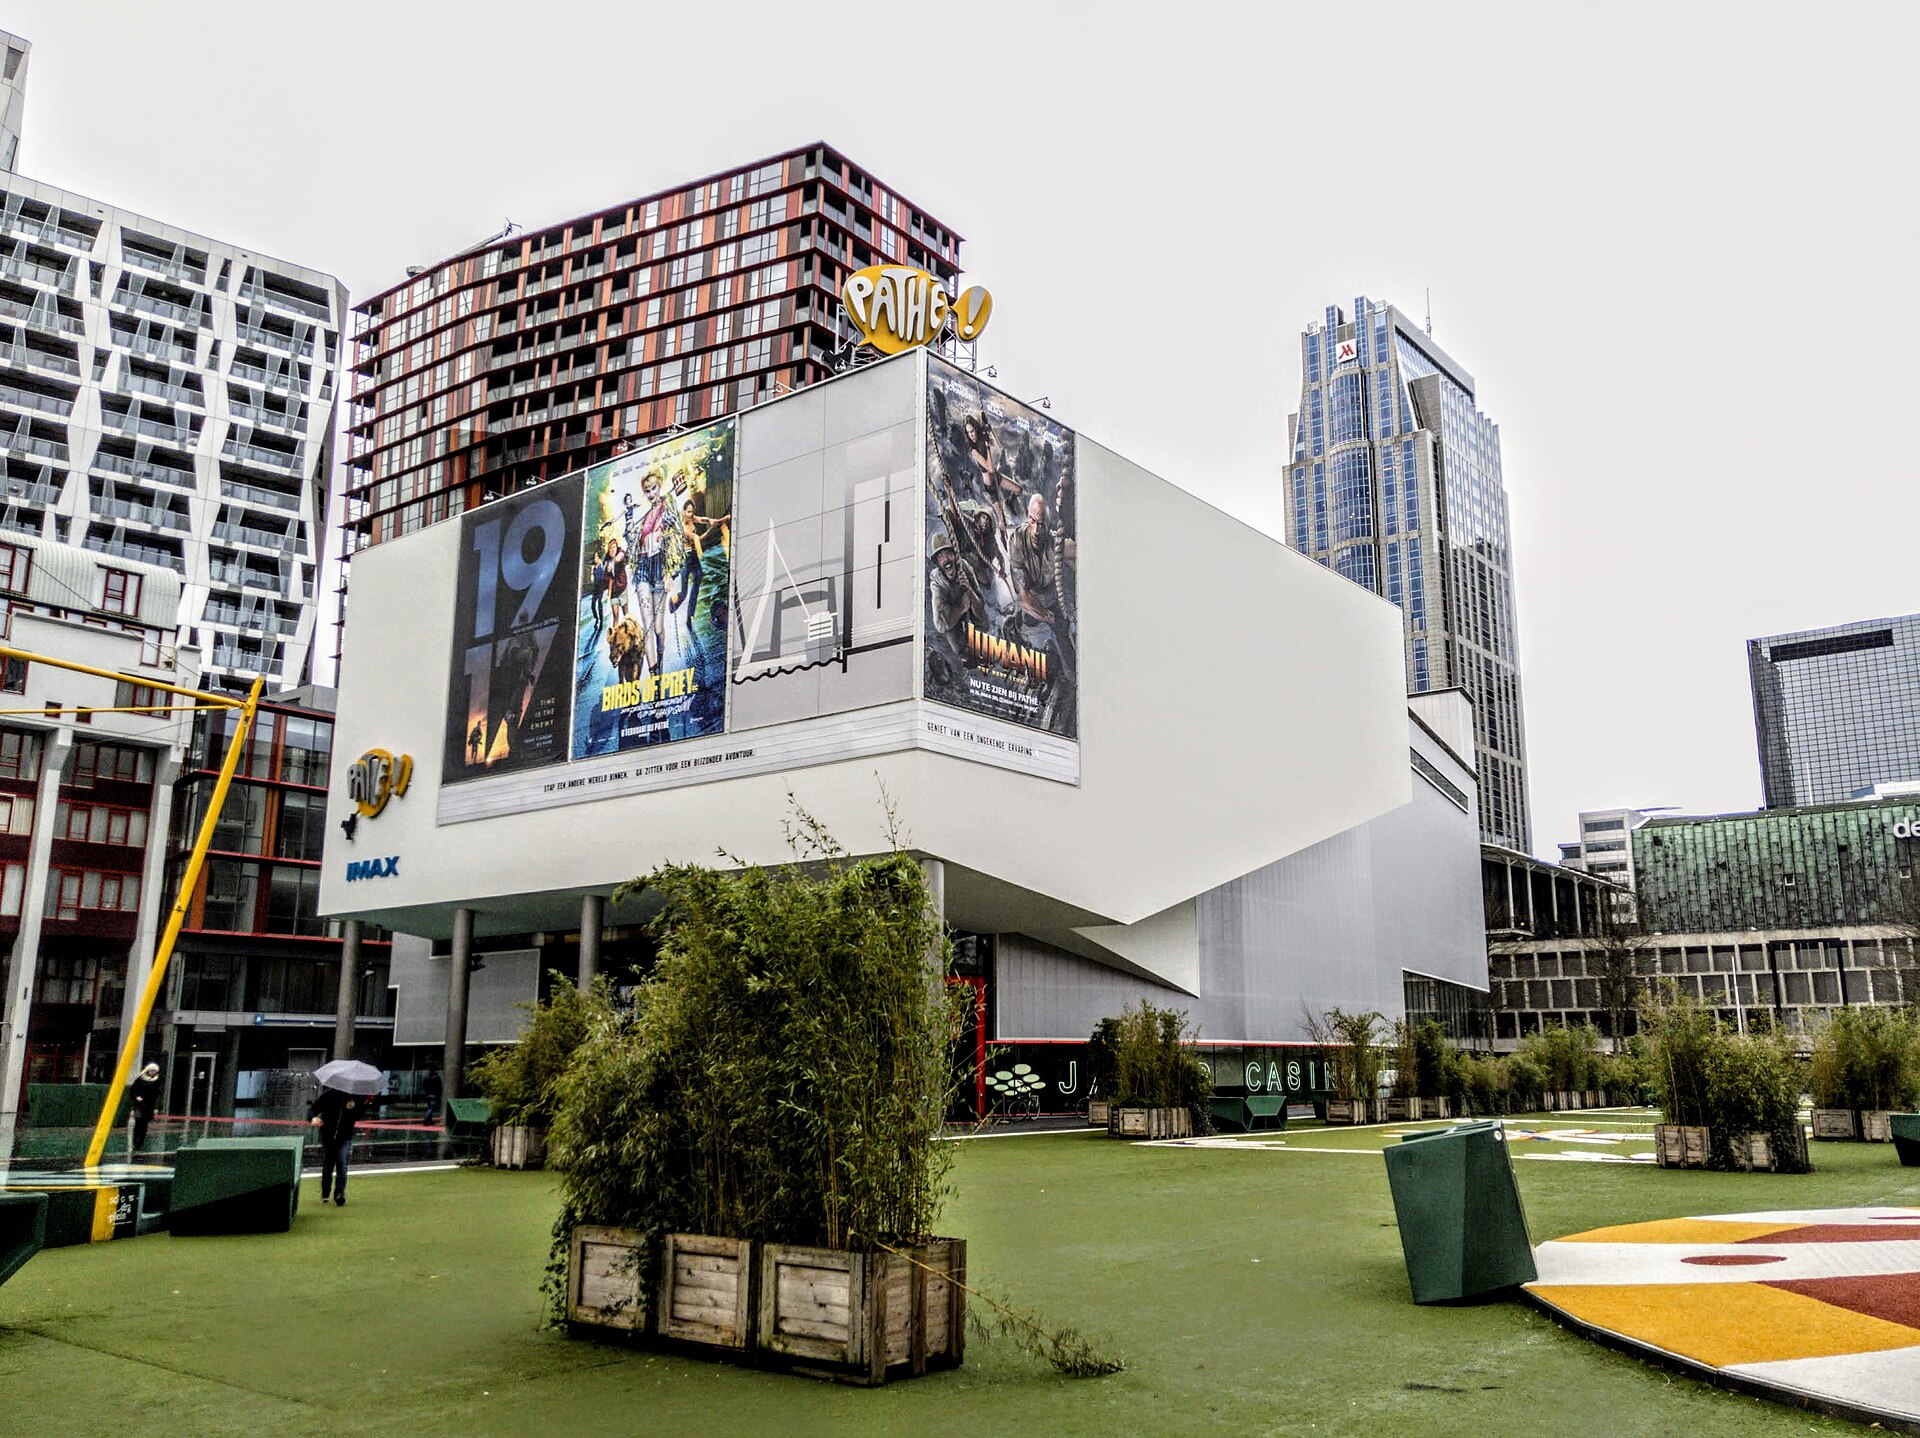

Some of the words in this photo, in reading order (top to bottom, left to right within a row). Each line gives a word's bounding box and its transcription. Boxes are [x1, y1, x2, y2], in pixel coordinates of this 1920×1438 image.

[473, 500, 566, 639] 19
[601, 679, 641, 713] BIRDS
[641, 675, 660, 704] OF
[660, 667, 696, 700] PREY
[970, 678, 981, 689] NU
[981, 681, 991, 692] TE
[991, 684, 1008, 697] ZIEN
[1008, 689, 1018, 701] BIJ
[927, 721, 948, 735] GENIET
[950, 728, 961, 738] VAN
[963, 731, 974, 741] EEN
[1008, 743, 1033, 757] ERVARING
[543, 783, 556, 793] STAP
[557, 781, 567, 790] EEN
[568, 777, 586, 788] ANDERE
[588, 774, 608, 785] WERELD
[635, 768, 643, 777] GA
[645, 765, 663, 775] ZITTEN
[665, 761, 679, 771] VOOR
[681, 759, 691, 769] EEN
[346, 856, 400, 882] IMAX
[1245, 1061, 1337, 1092] CASIN
